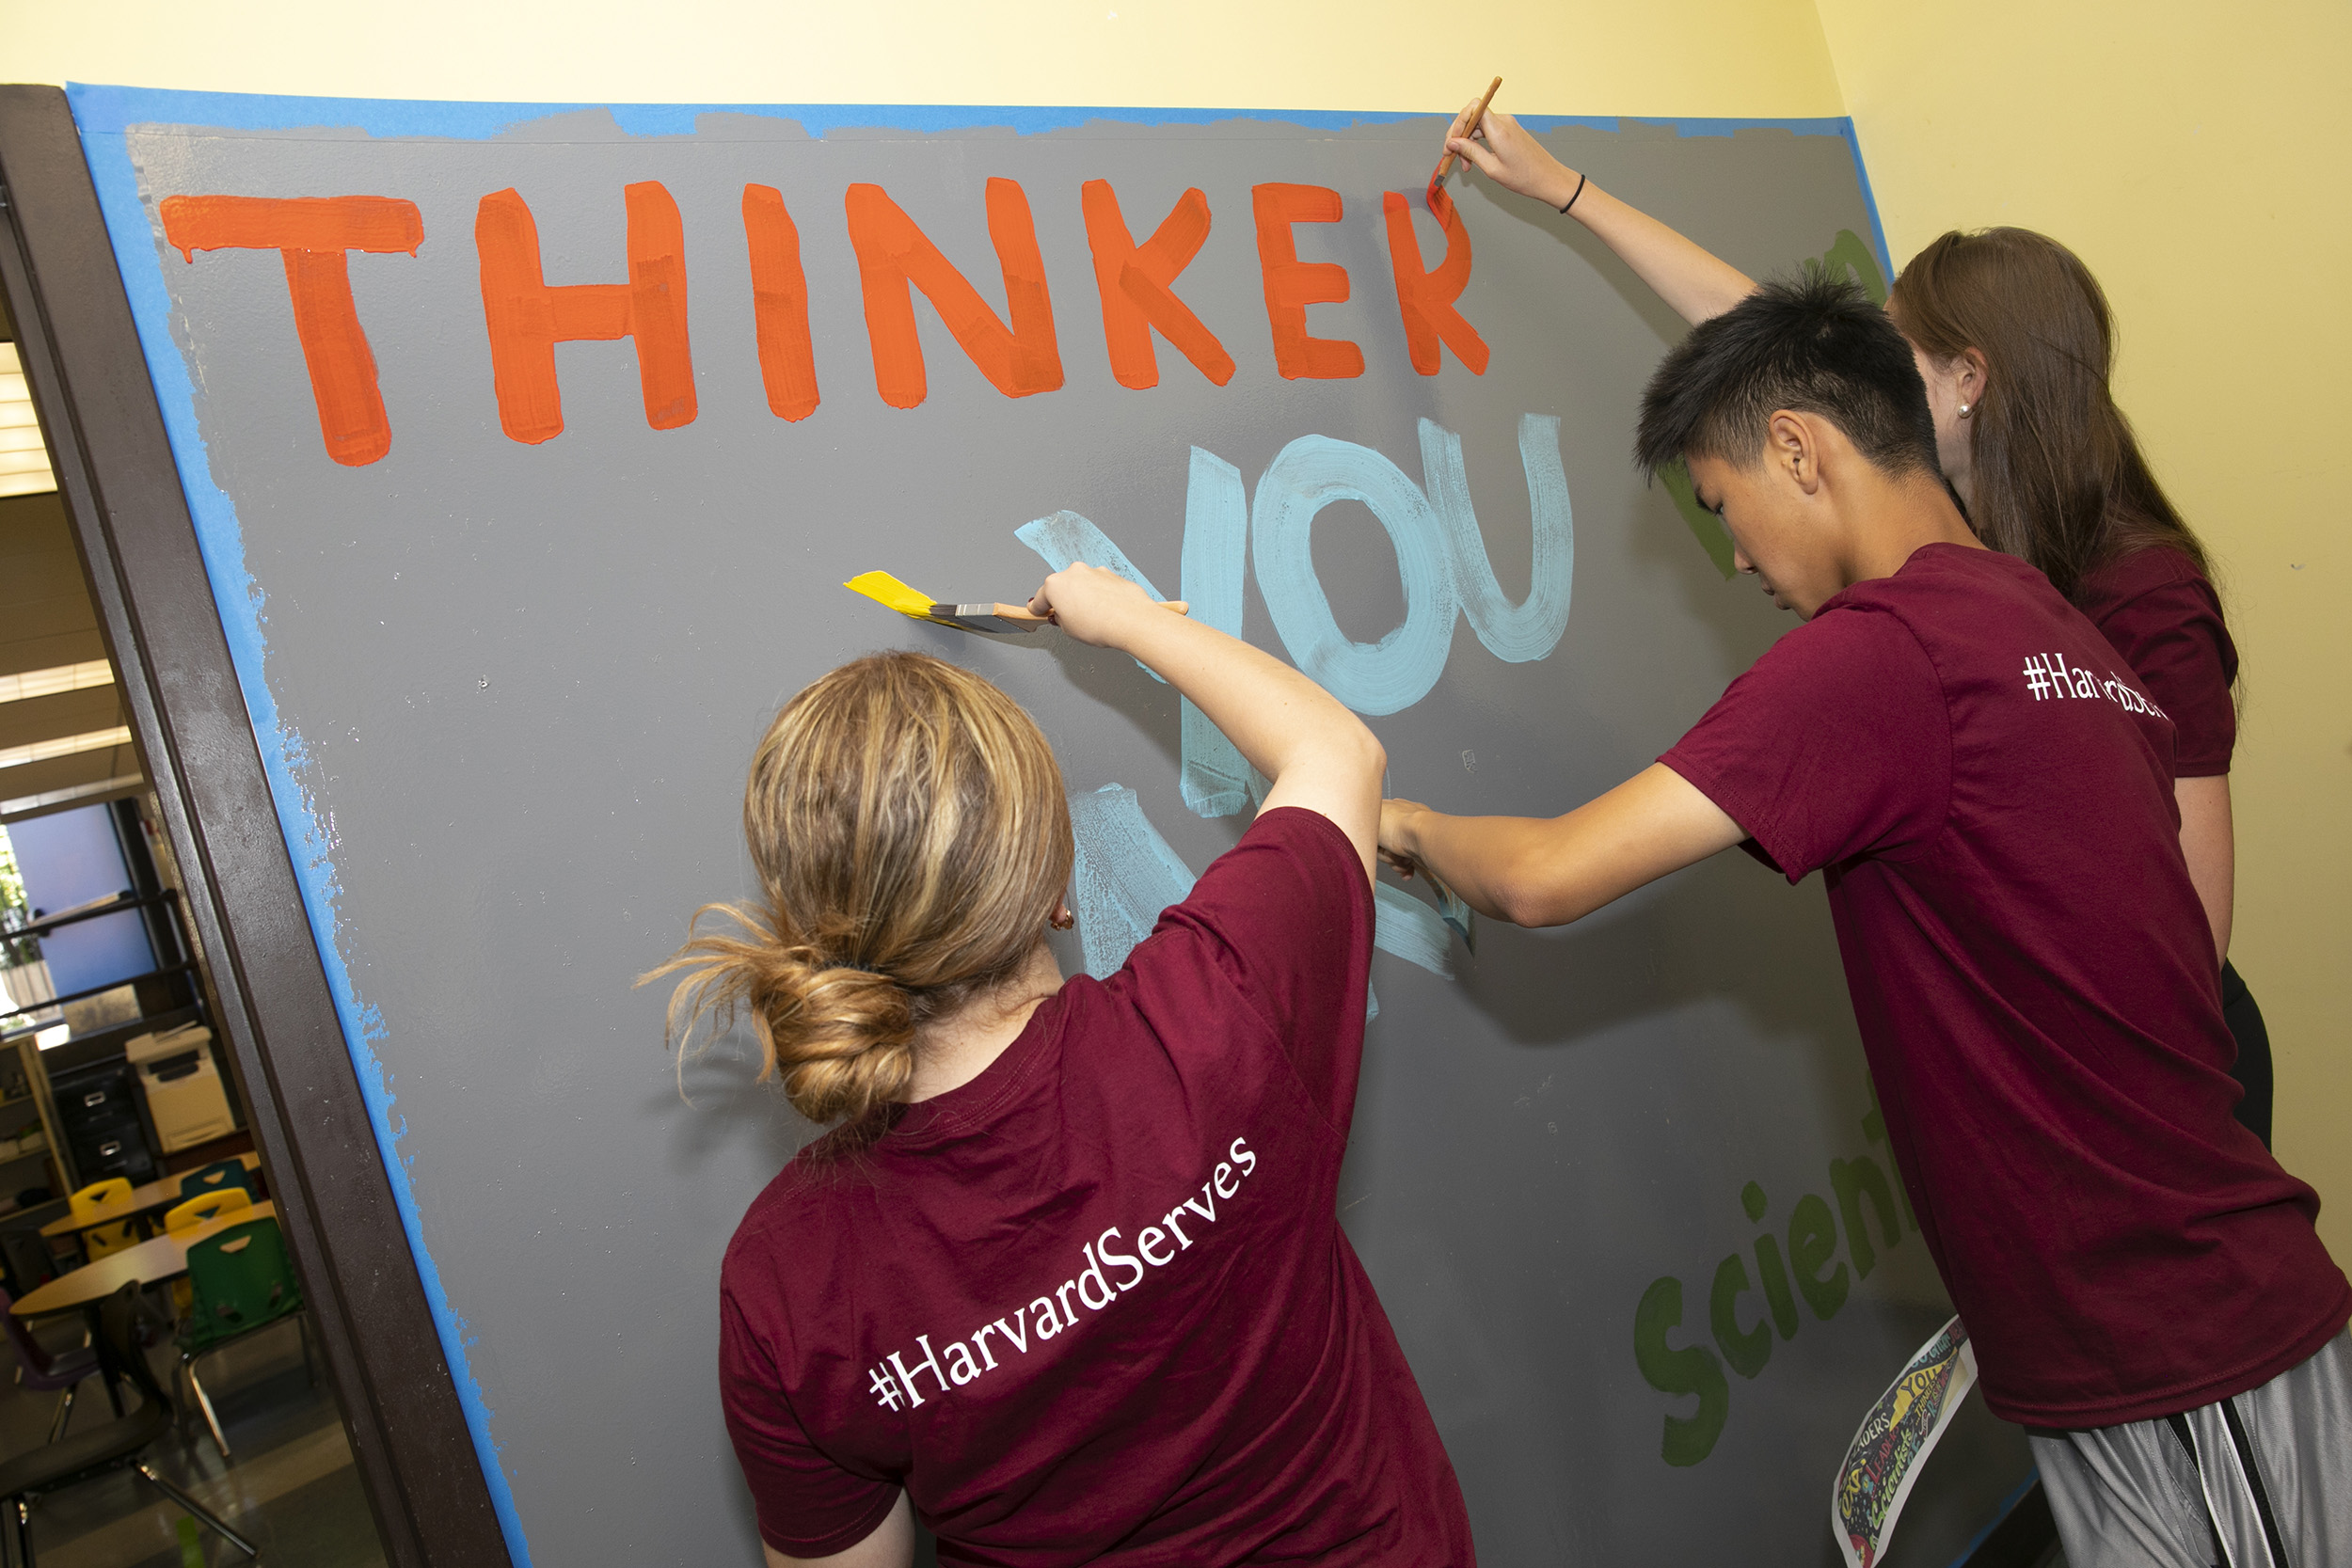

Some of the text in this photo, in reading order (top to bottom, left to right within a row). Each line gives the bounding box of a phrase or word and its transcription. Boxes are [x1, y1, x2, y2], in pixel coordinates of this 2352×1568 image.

[160, 179, 1490, 467] THINKER
[1013, 413, 1574, 817] YOU
[868, 1137, 1256, 1412] #HarvardServes
[1855, 1412, 1891, 1454] ADERS
